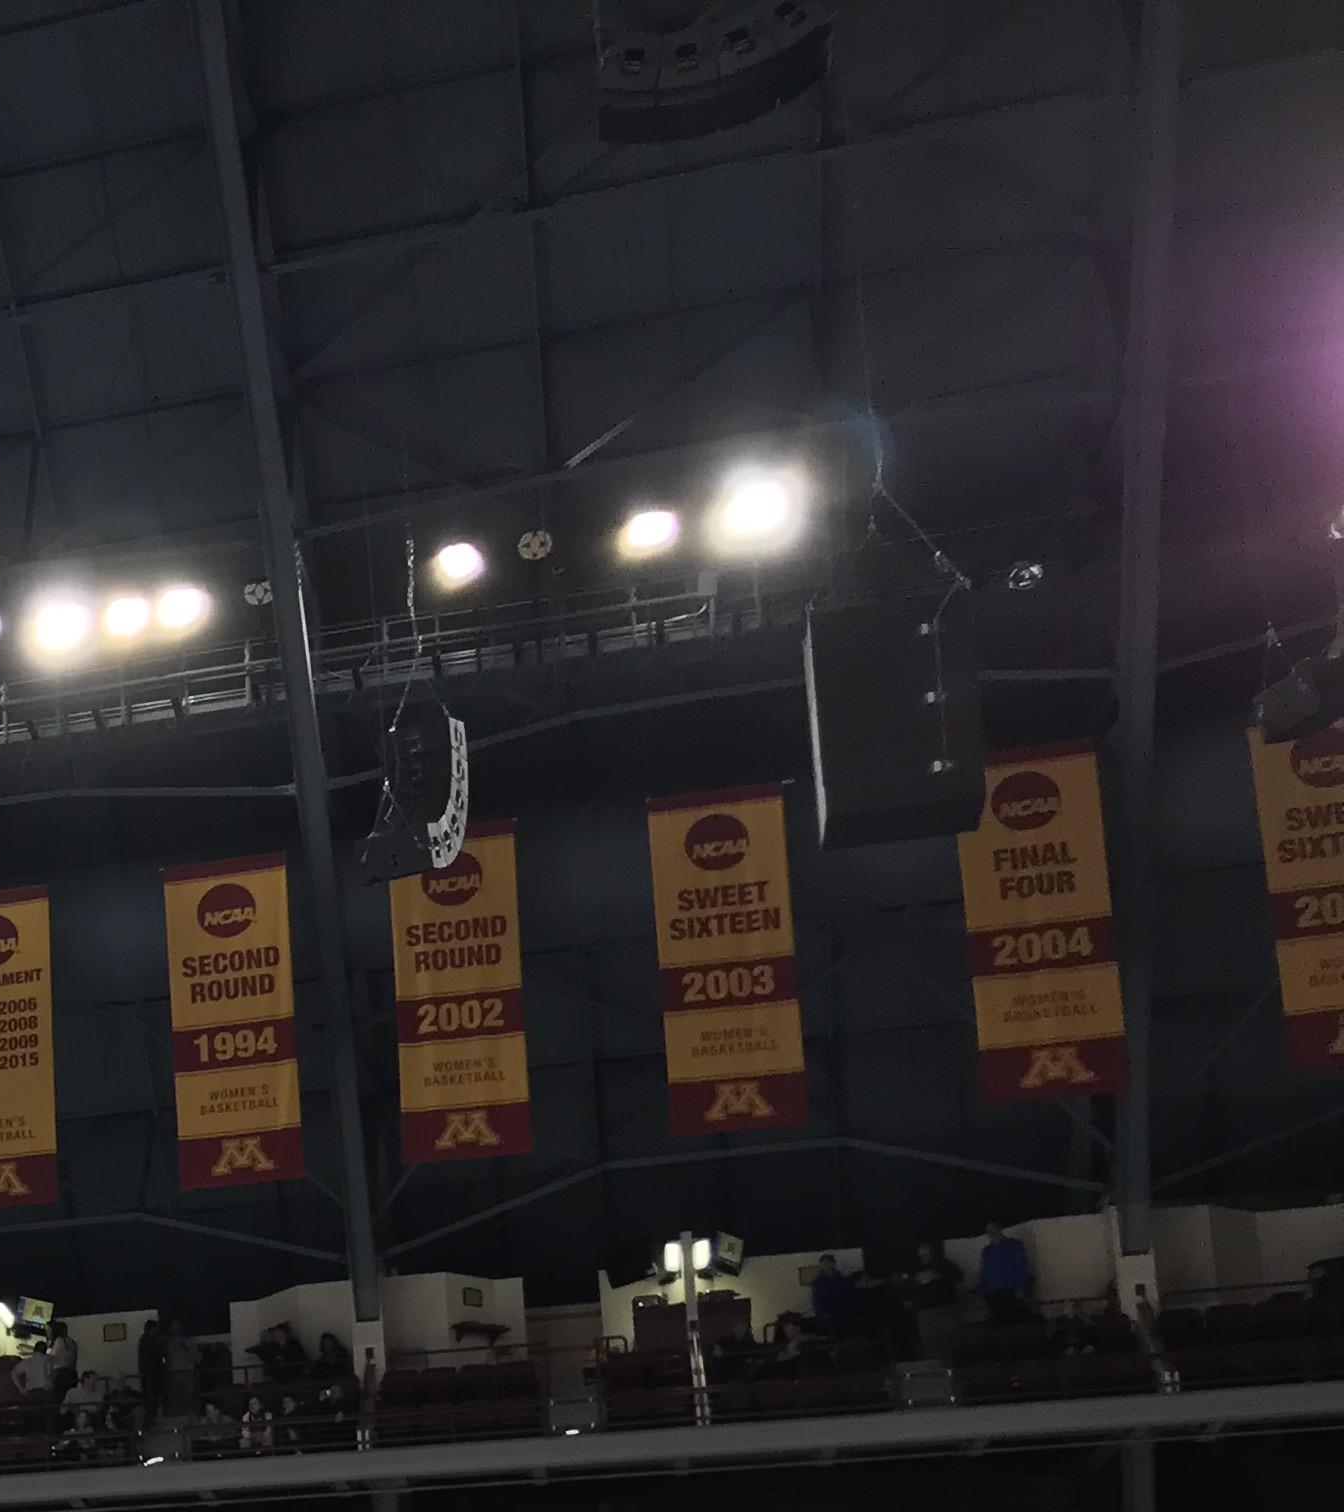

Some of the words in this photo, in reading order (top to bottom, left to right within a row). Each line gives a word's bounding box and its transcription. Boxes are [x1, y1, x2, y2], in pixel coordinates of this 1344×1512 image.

[993, 841, 1077, 872] FINAL
[678, 880, 768, 912] SWEET
[999, 870, 1076, 900] FOUR
[406, 915, 507, 947] SECOND
[669, 907, 781, 941] SIXTEEN
[182, 945, 280, 979] SECOND
[415, 943, 501, 974] ROUND
[993, 926, 1094, 967] 2004
[190, 974, 275, 1004] ROUND
[682, 964, 775, 1003] 2003
[417, 998, 505, 1035] 2002
[194, 1027, 278, 1063] 1994
[0, 1052, 39, 1071] 2015
[424, 1070, 506, 1087] BASKETBALL
[200, 1098, 279, 1116] BASKETBALL
[434, 1109, 505, 1150] M
[211, 1135, 275, 1177] M
